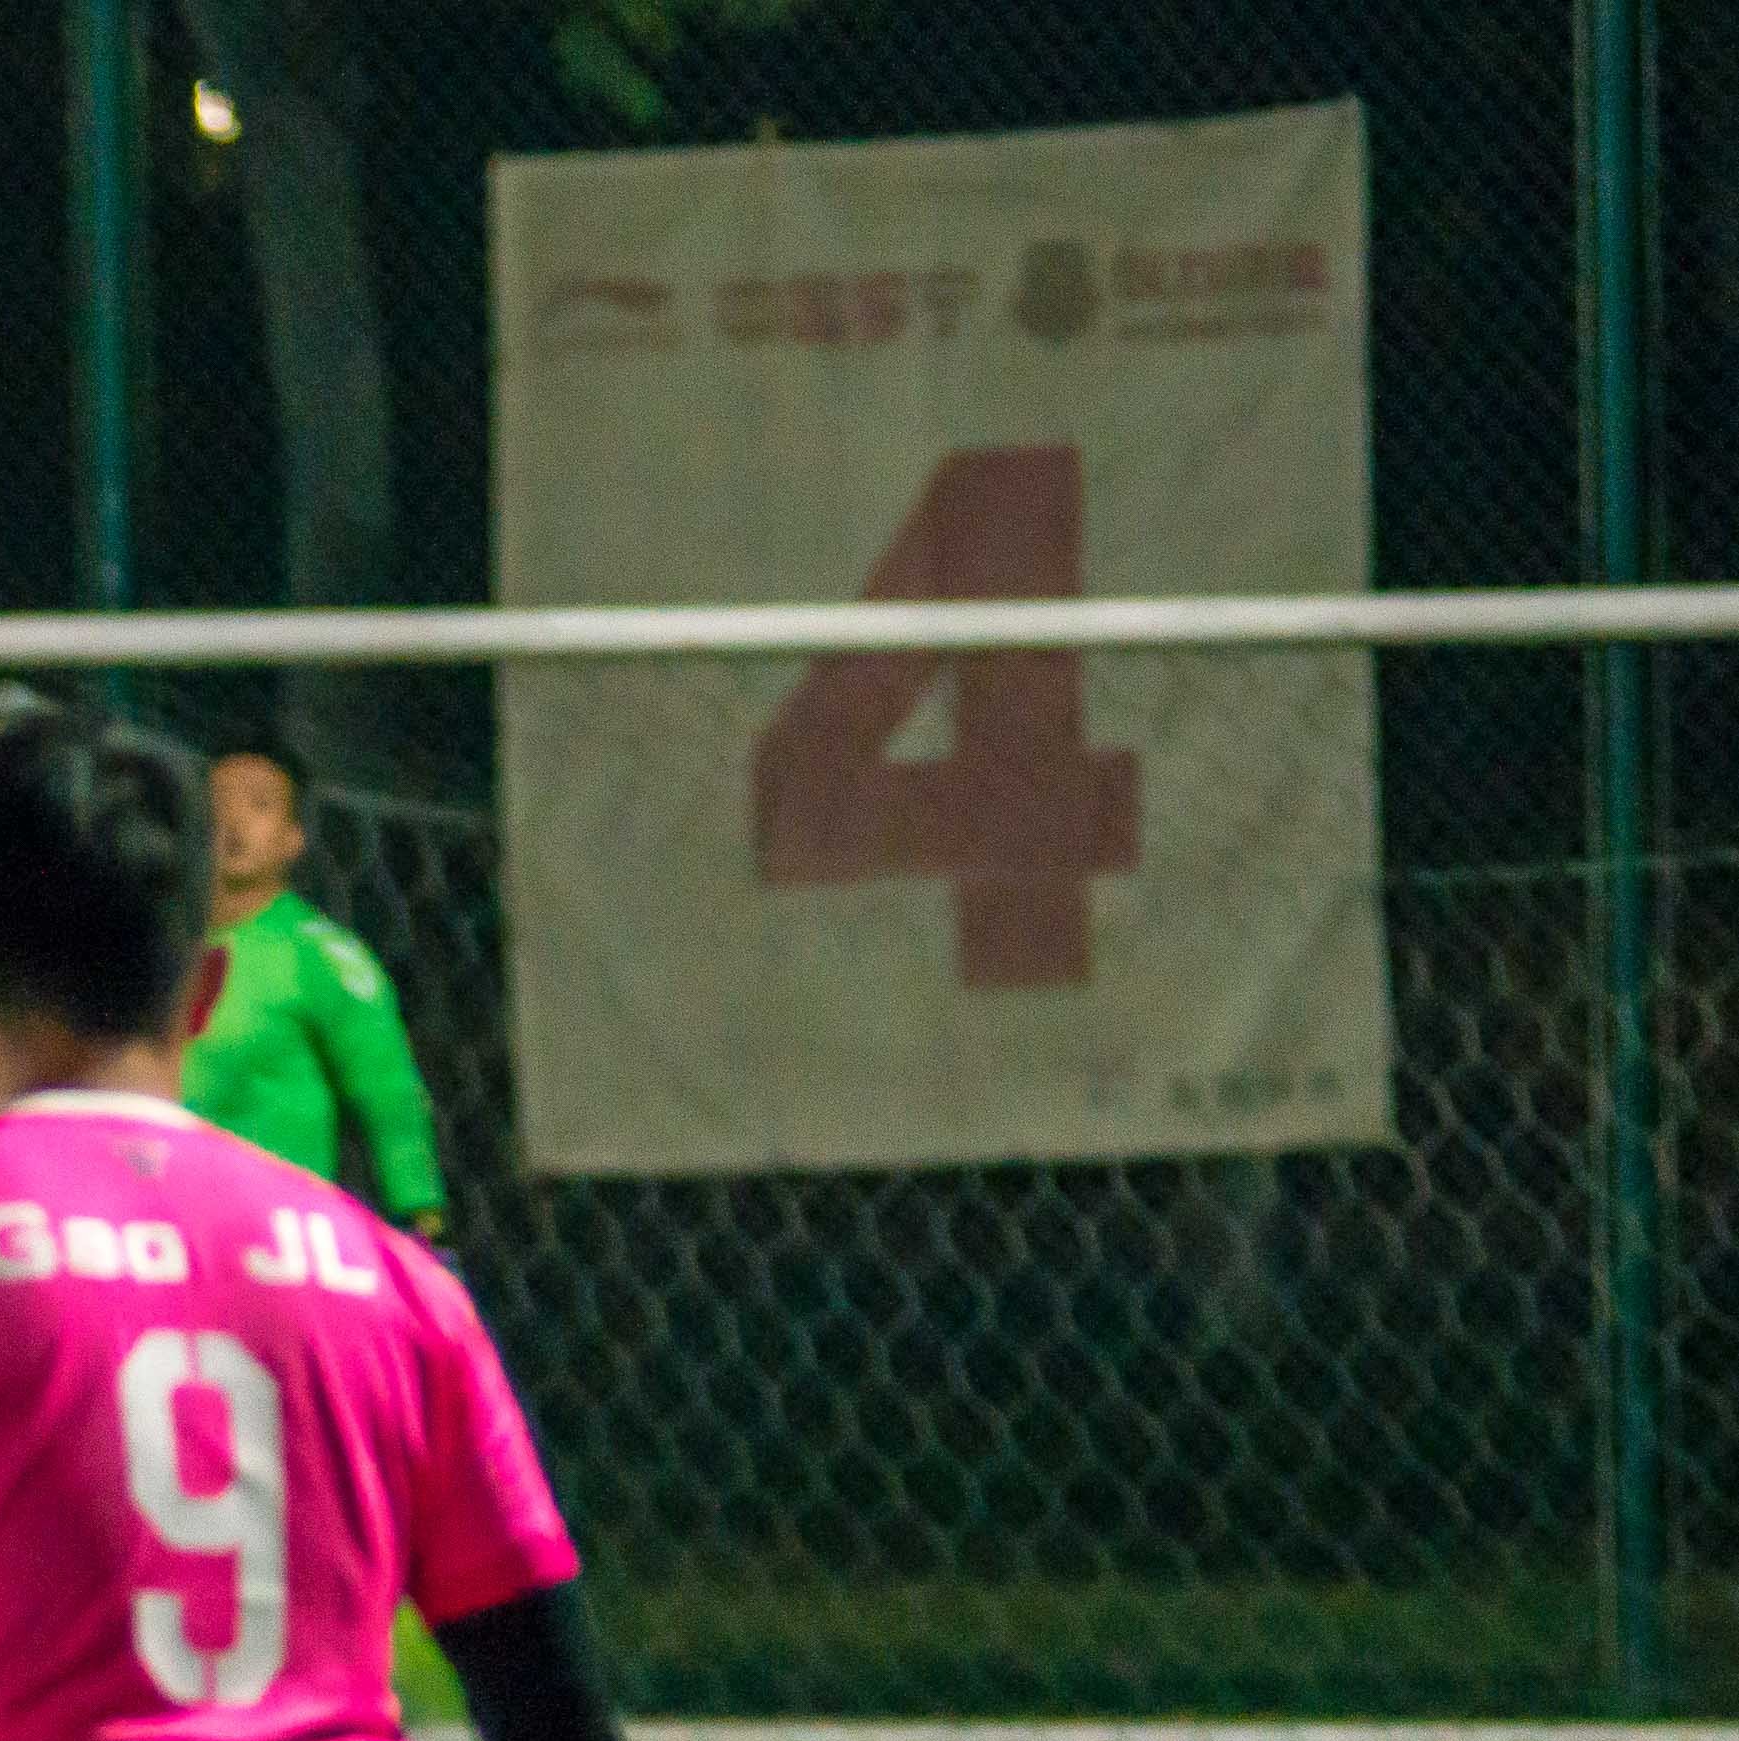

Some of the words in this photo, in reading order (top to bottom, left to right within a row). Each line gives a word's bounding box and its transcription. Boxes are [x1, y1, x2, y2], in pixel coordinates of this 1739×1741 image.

[751, 441, 1143, 988] 4
[244, 1207, 379, 1296] JL
[119, 1328, 288, 1708] 9
